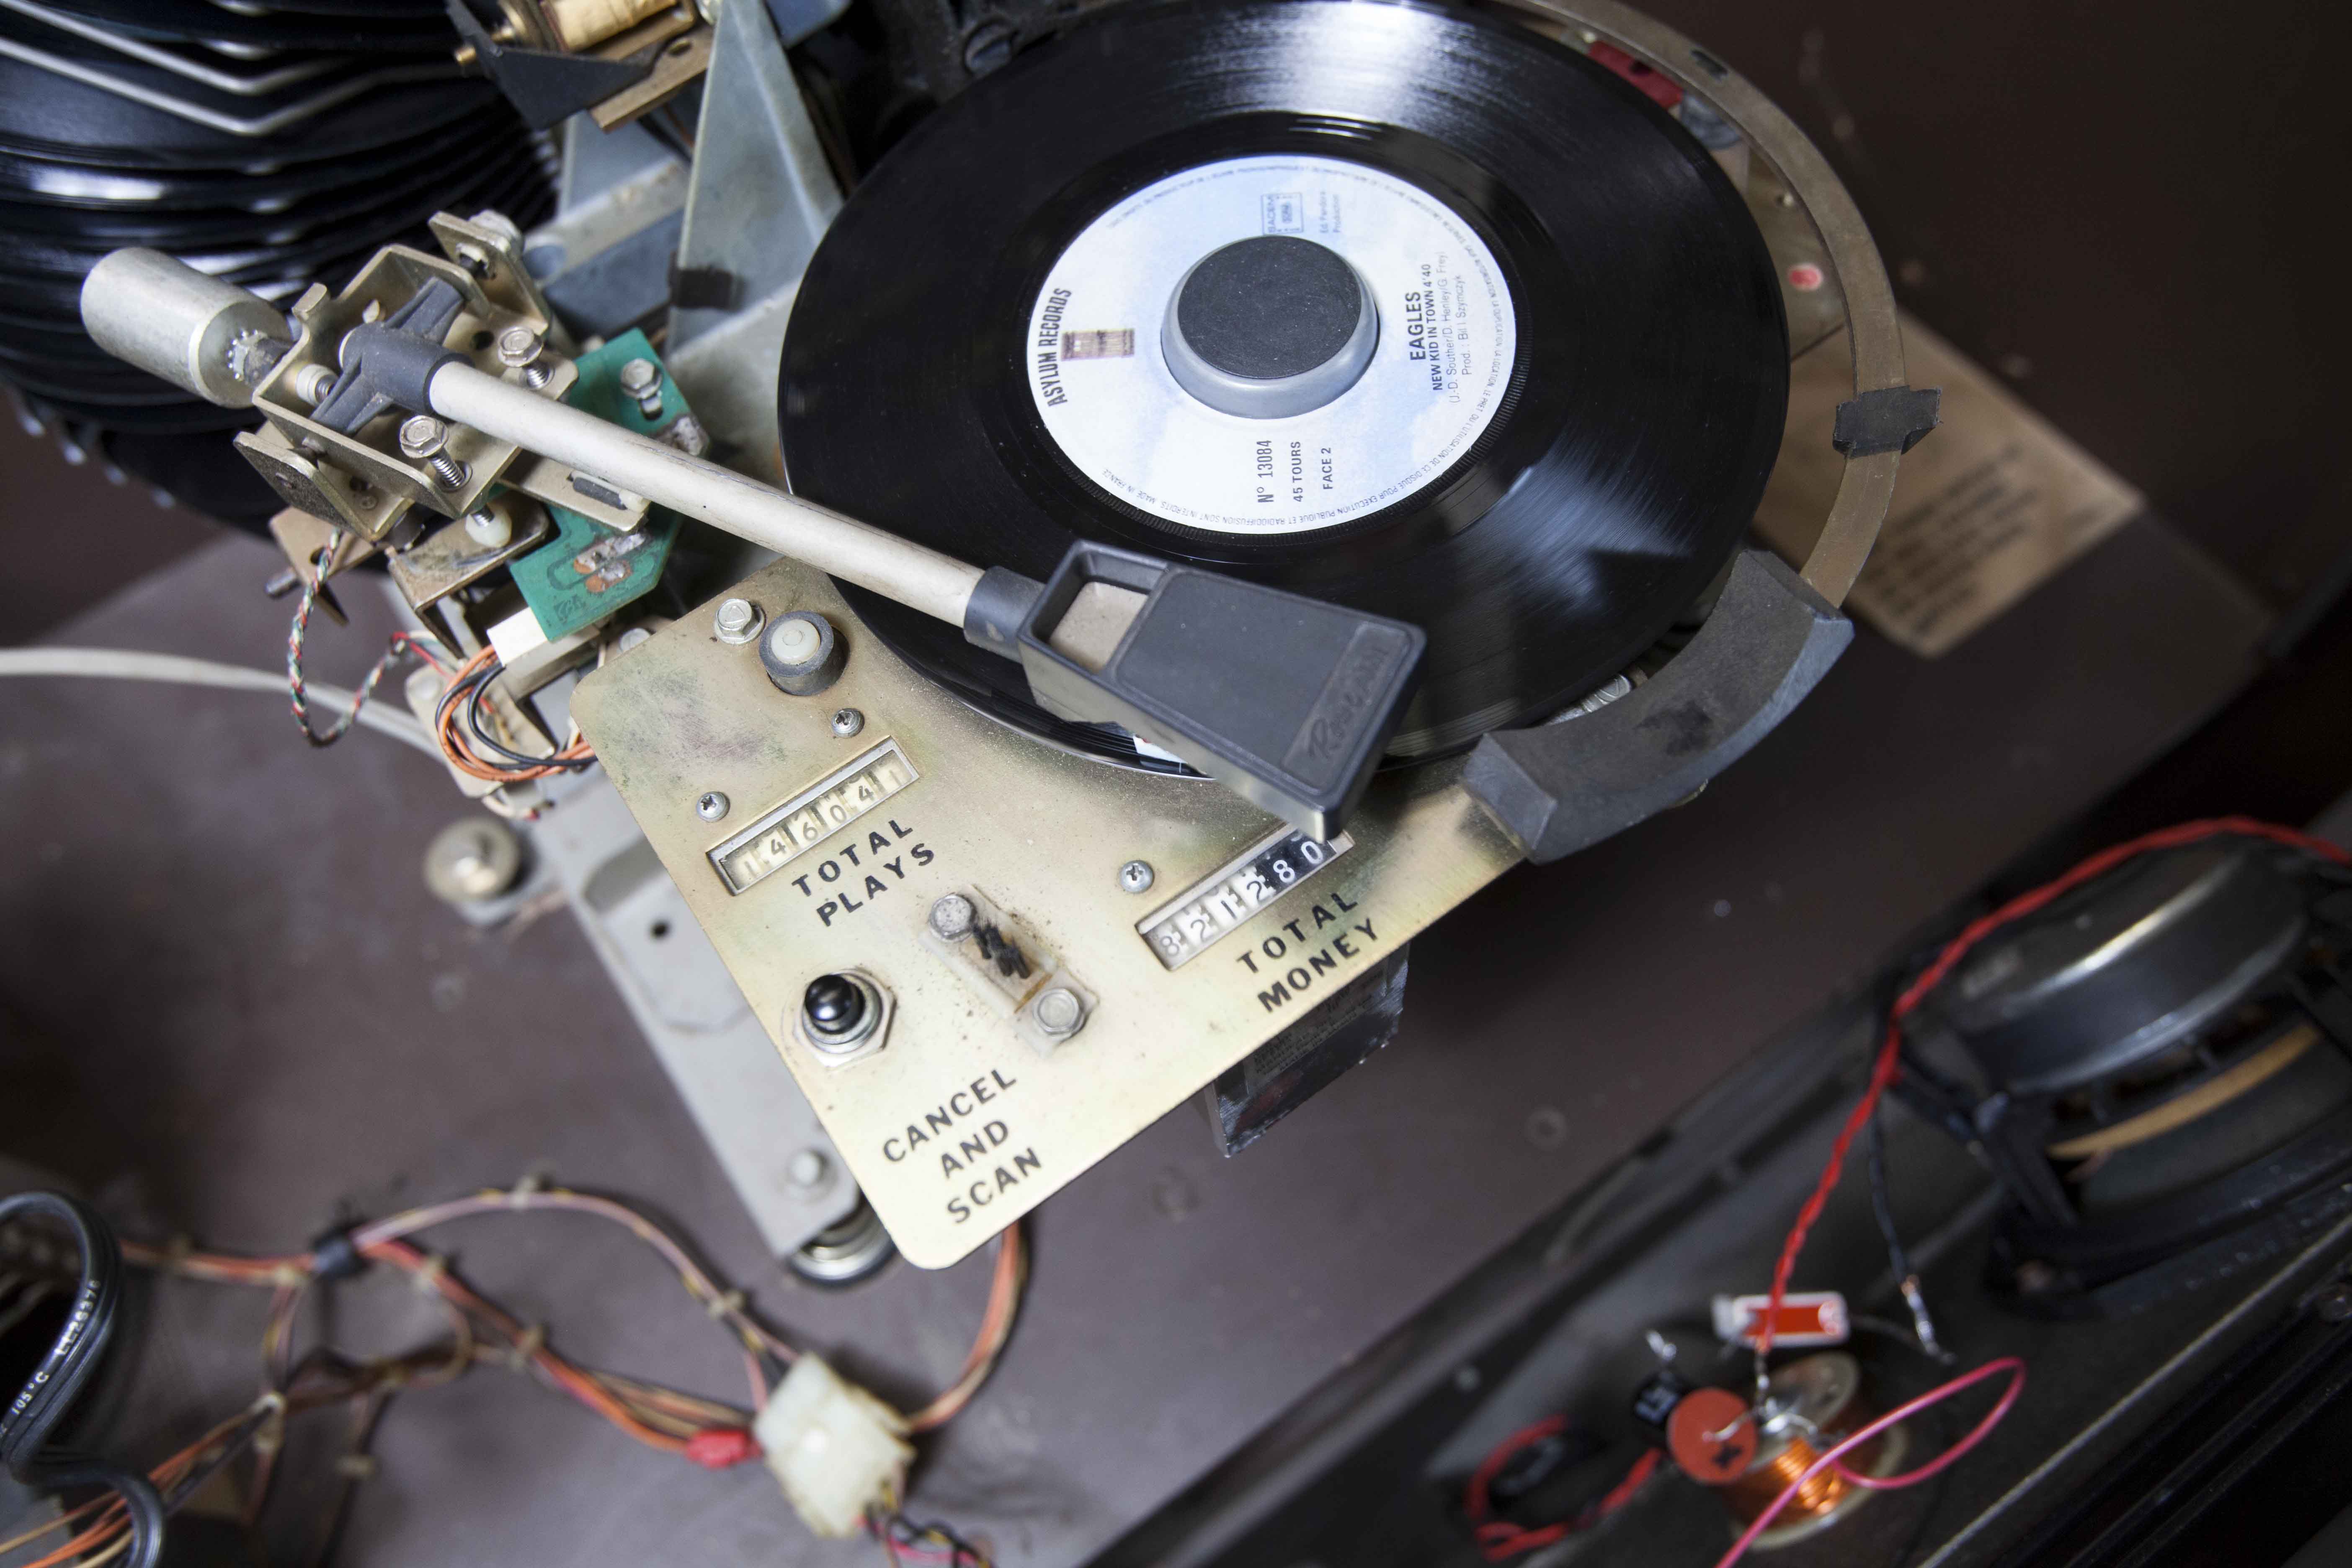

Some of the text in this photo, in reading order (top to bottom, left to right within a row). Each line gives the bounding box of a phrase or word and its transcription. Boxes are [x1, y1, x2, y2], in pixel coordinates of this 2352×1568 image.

[1454, 275, 1467, 318] Szymczyk
[1038, 289, 1071, 406] ASYLUM RECORDS
[1405, 292, 1426, 360] EAGLES
[1421, 265, 1442, 390] NEW KID IN TOWN 4'40
[1442, 326, 1457, 375] Souther/D.
[1461, 351, 1472, 375] Prod.
[1100, 468, 1128, 489] FRANCE
[1124, 485, 1136, 494] IN
[1135, 490, 1157, 504] MADE
[1256, 440, 1274, 503] N° 13084
[1290, 441, 1303, 502] 45 TOURS
[1321, 459, 1333, 490] FACE
[1377, 485, 1399, 500] POUR
[1397, 470, 1424, 489] DISQUE
[1288, 516, 1297, 524] ET
[1298, 509, 1336, 523] PUBLIQUE
[1336, 495, 1379, 515] EXECUTION
[791, 819, 914, 897] TOTAL
[815, 843, 935, 927] PLAYS
[1237, 892, 1358, 974] TOTAL
[1257, 918, 1380, 1013] MONEY
[882, 1068, 1017, 1162] CANCEL
[939, 1119, 1008, 1179] AND
[947, 1147, 1042, 1225] SCAN
